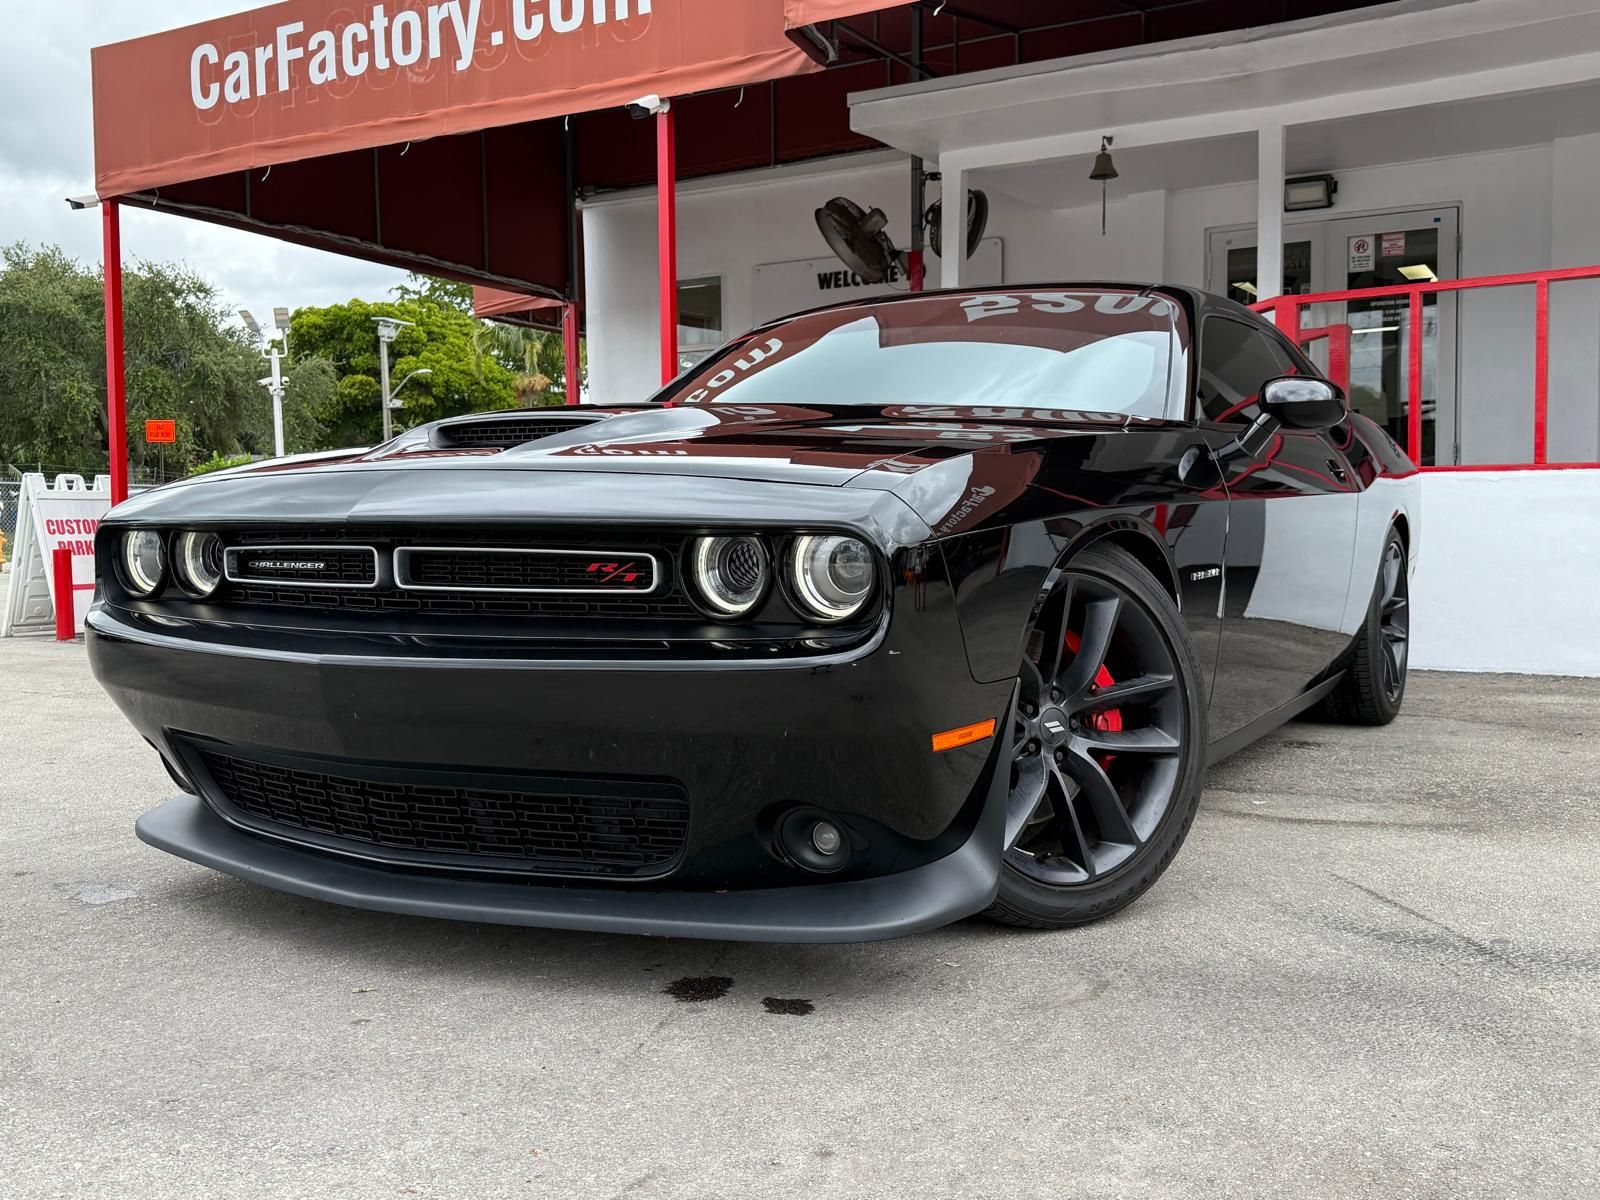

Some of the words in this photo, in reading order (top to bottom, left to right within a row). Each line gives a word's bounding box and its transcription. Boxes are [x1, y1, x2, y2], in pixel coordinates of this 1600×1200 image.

[817, 265, 898, 290] WELCE
[248, 561, 325, 569] CHALLENGER
[586, 562, 646, 582] R/T
